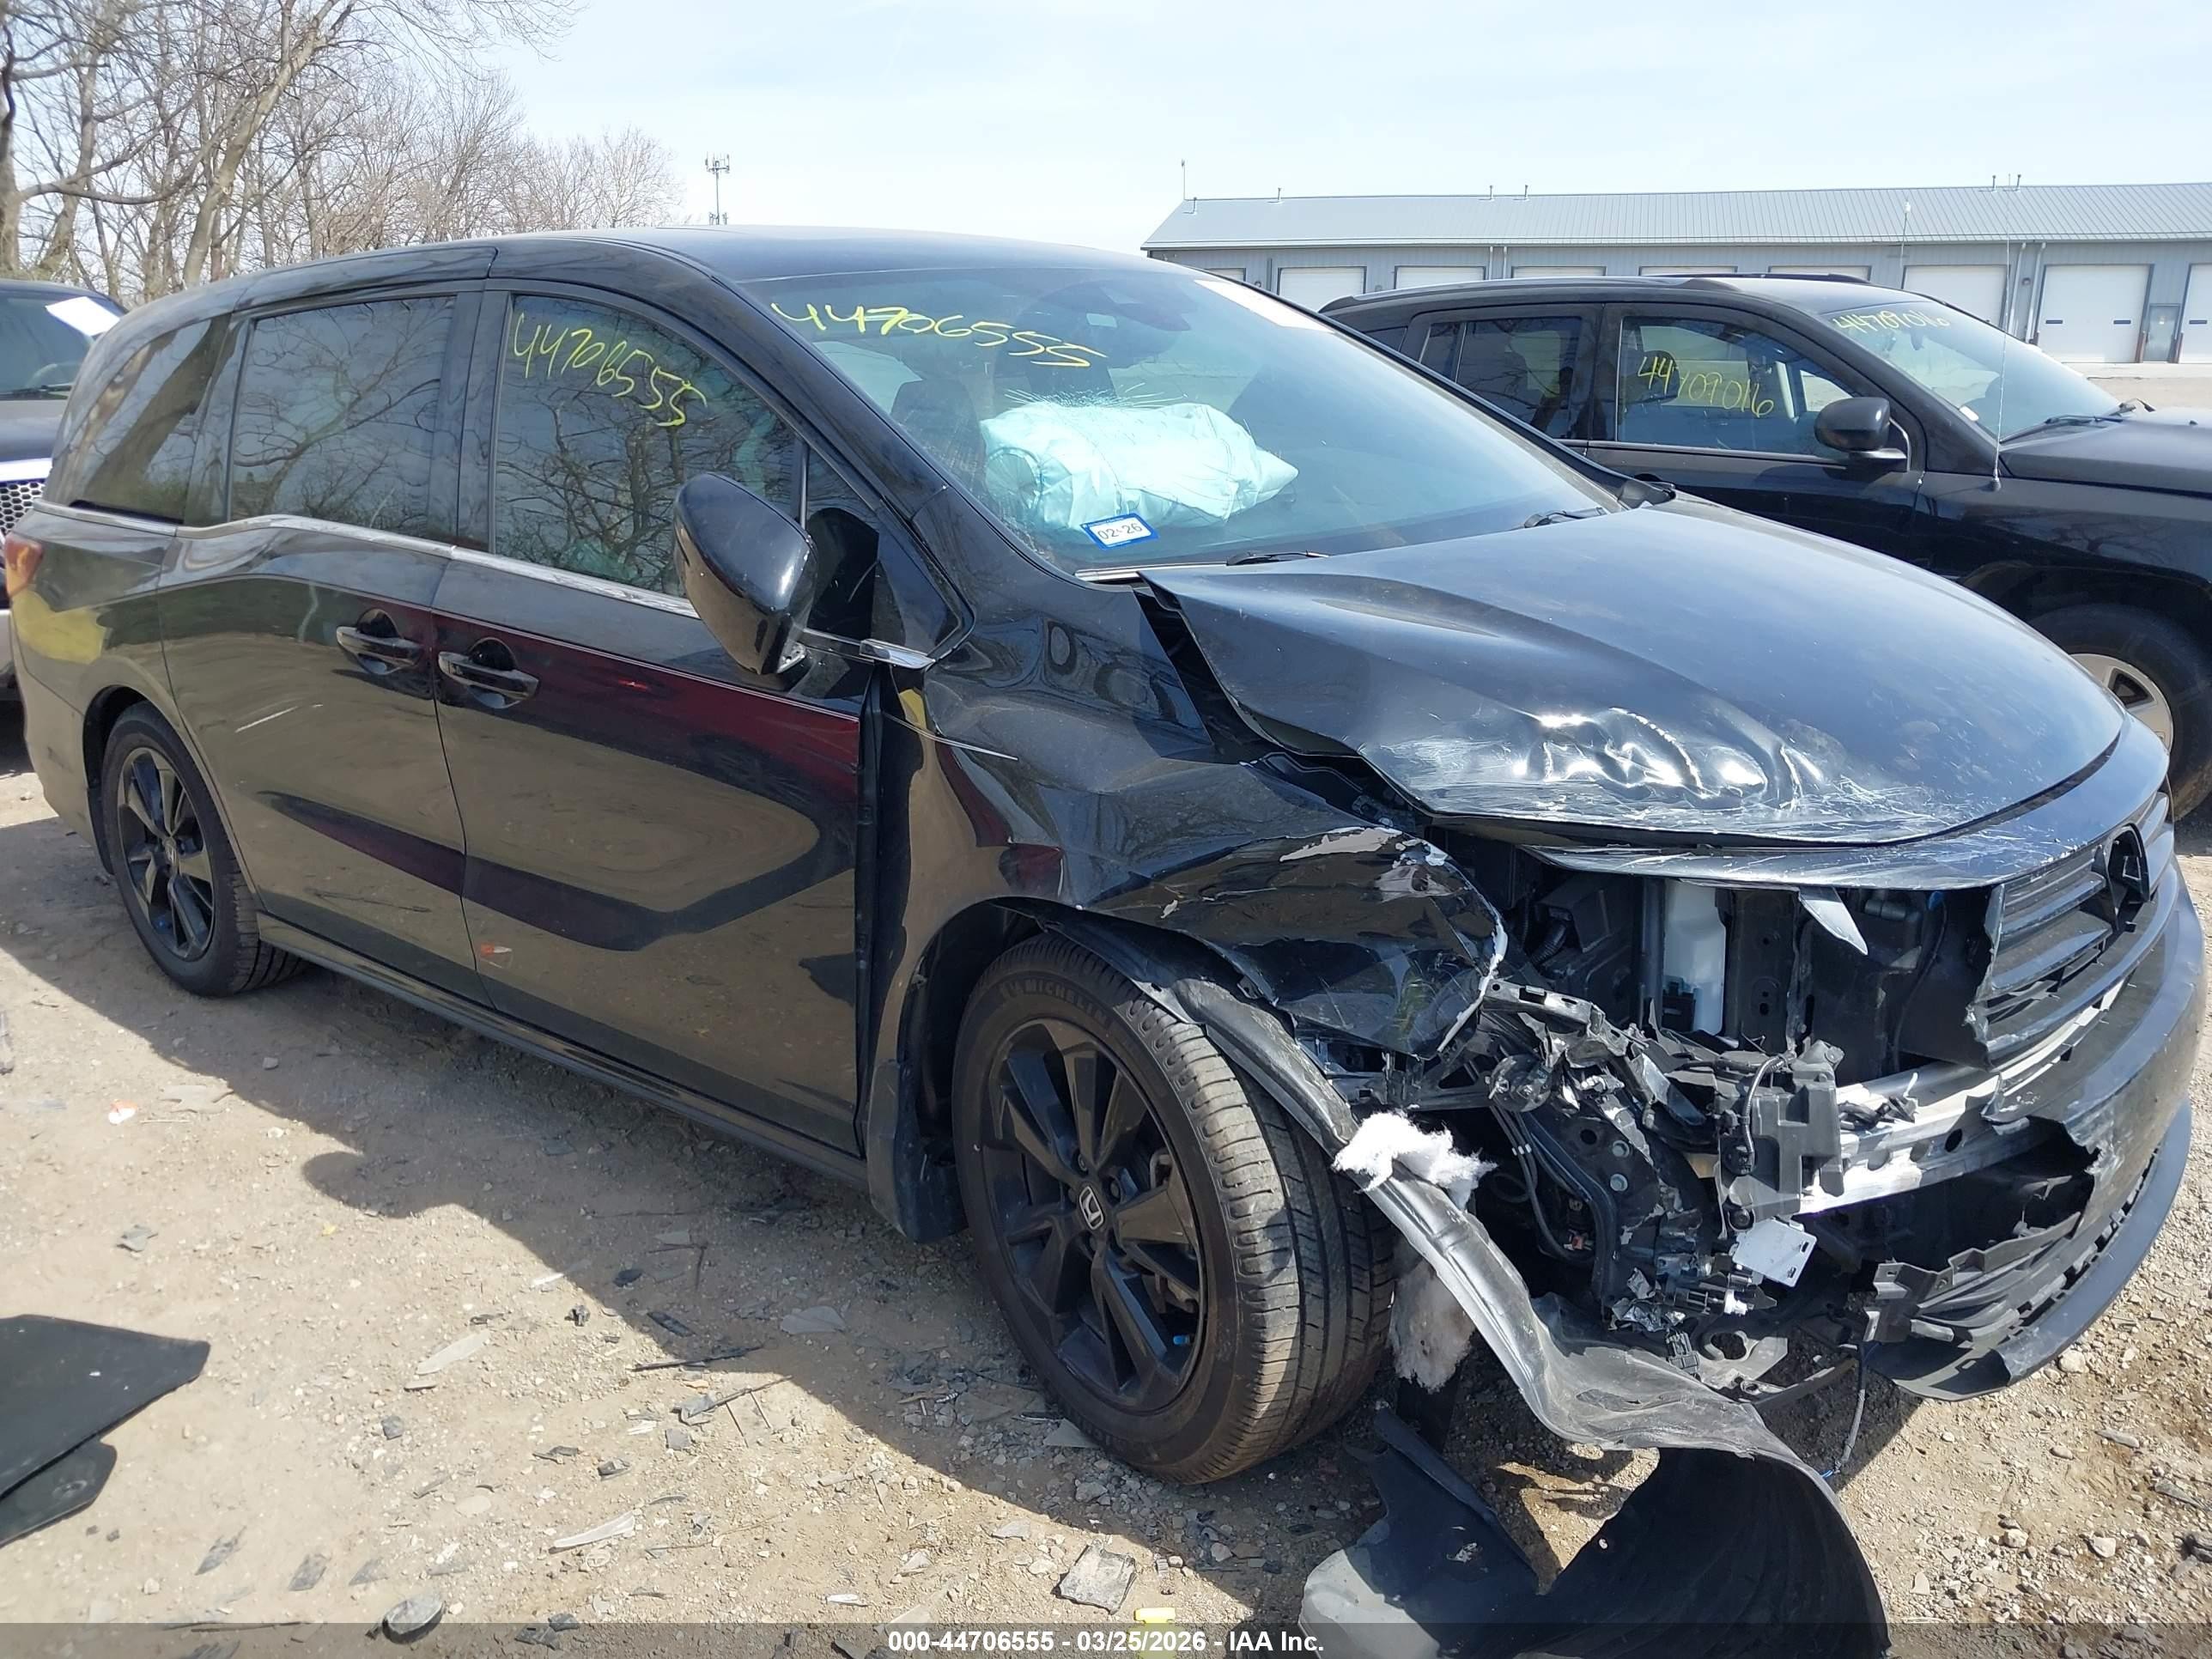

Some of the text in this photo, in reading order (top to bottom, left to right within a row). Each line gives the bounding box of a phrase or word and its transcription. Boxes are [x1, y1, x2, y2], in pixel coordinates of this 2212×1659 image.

[771, 303, 1108, 368] 44706555
[514, 313, 708, 427] 44706555
[1024, 978, 1108, 1026] MICHELIN
